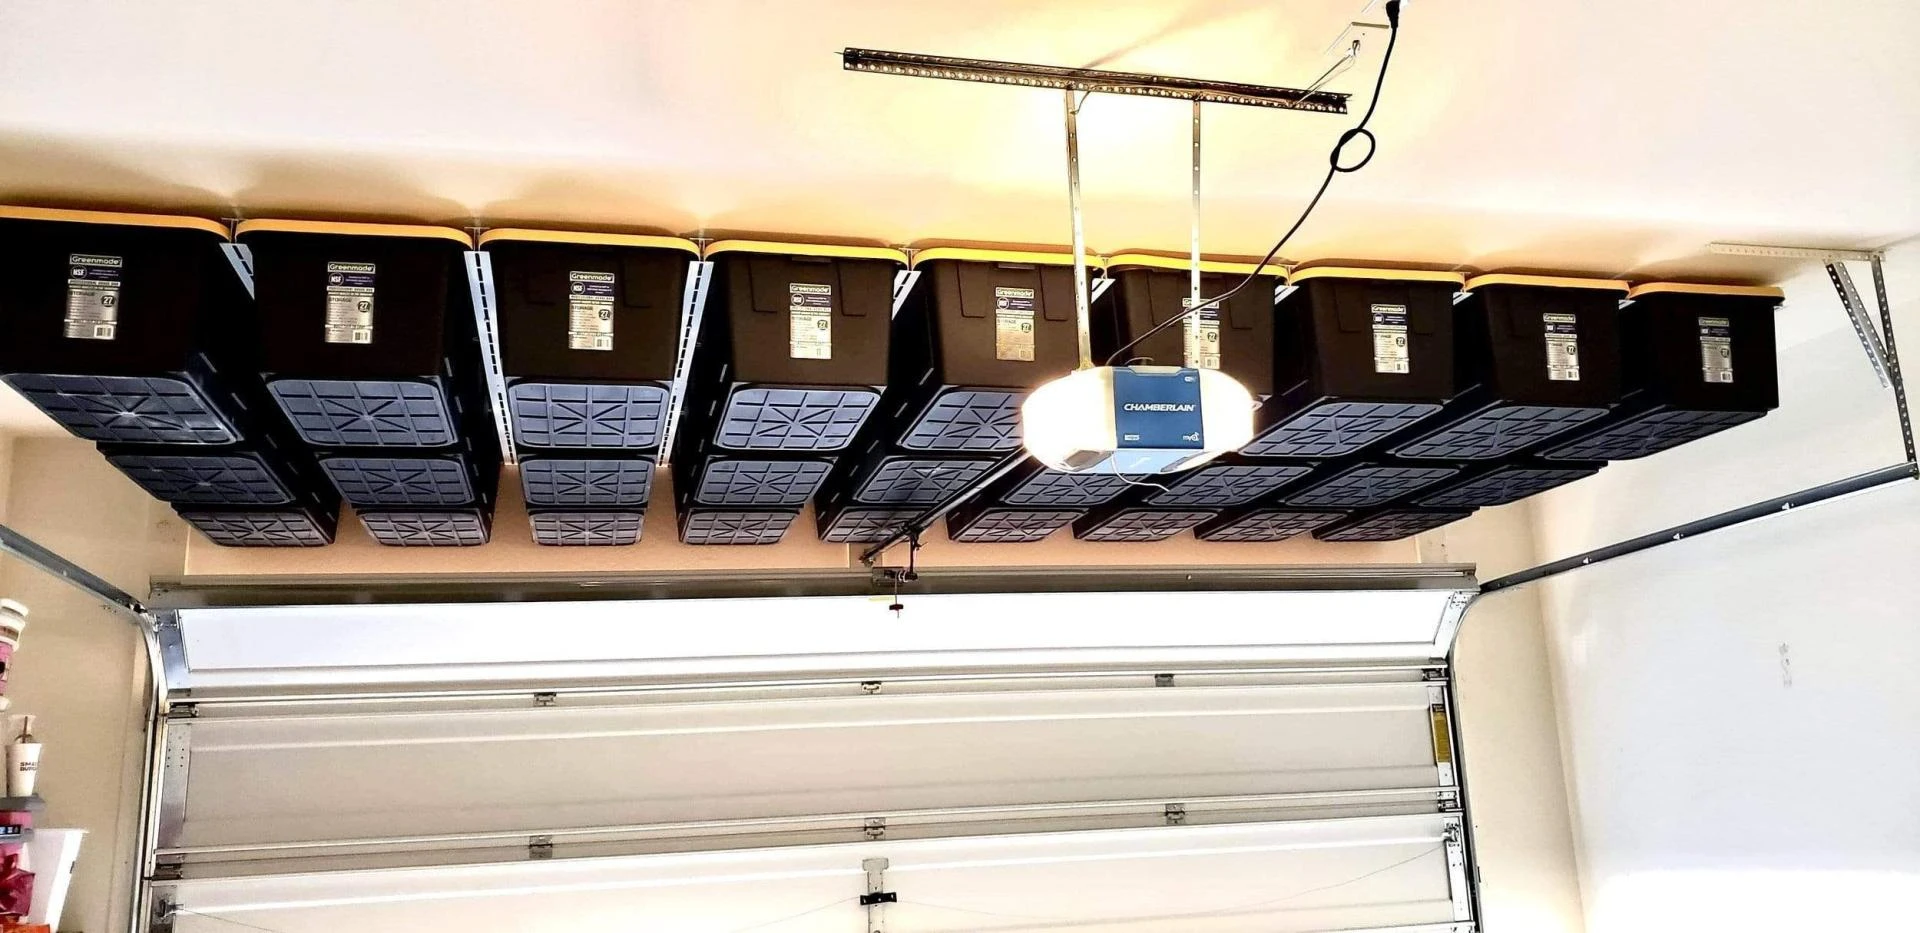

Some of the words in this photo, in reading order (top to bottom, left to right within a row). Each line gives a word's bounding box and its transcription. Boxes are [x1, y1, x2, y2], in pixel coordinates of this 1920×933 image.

[72, 255, 119, 265] Greenmade
[329, 263, 373, 271] Greenmade
[72, 268, 84, 276] NSF
[331, 275, 341, 283] NSF
[571, 273, 612, 281] Greenmade
[791, 285, 830, 293] Greenmade
[103, 296, 113, 305] 27
[360, 302, 369, 310] 27
[1124, 403, 1194, 412] CHAMBERLAIN
